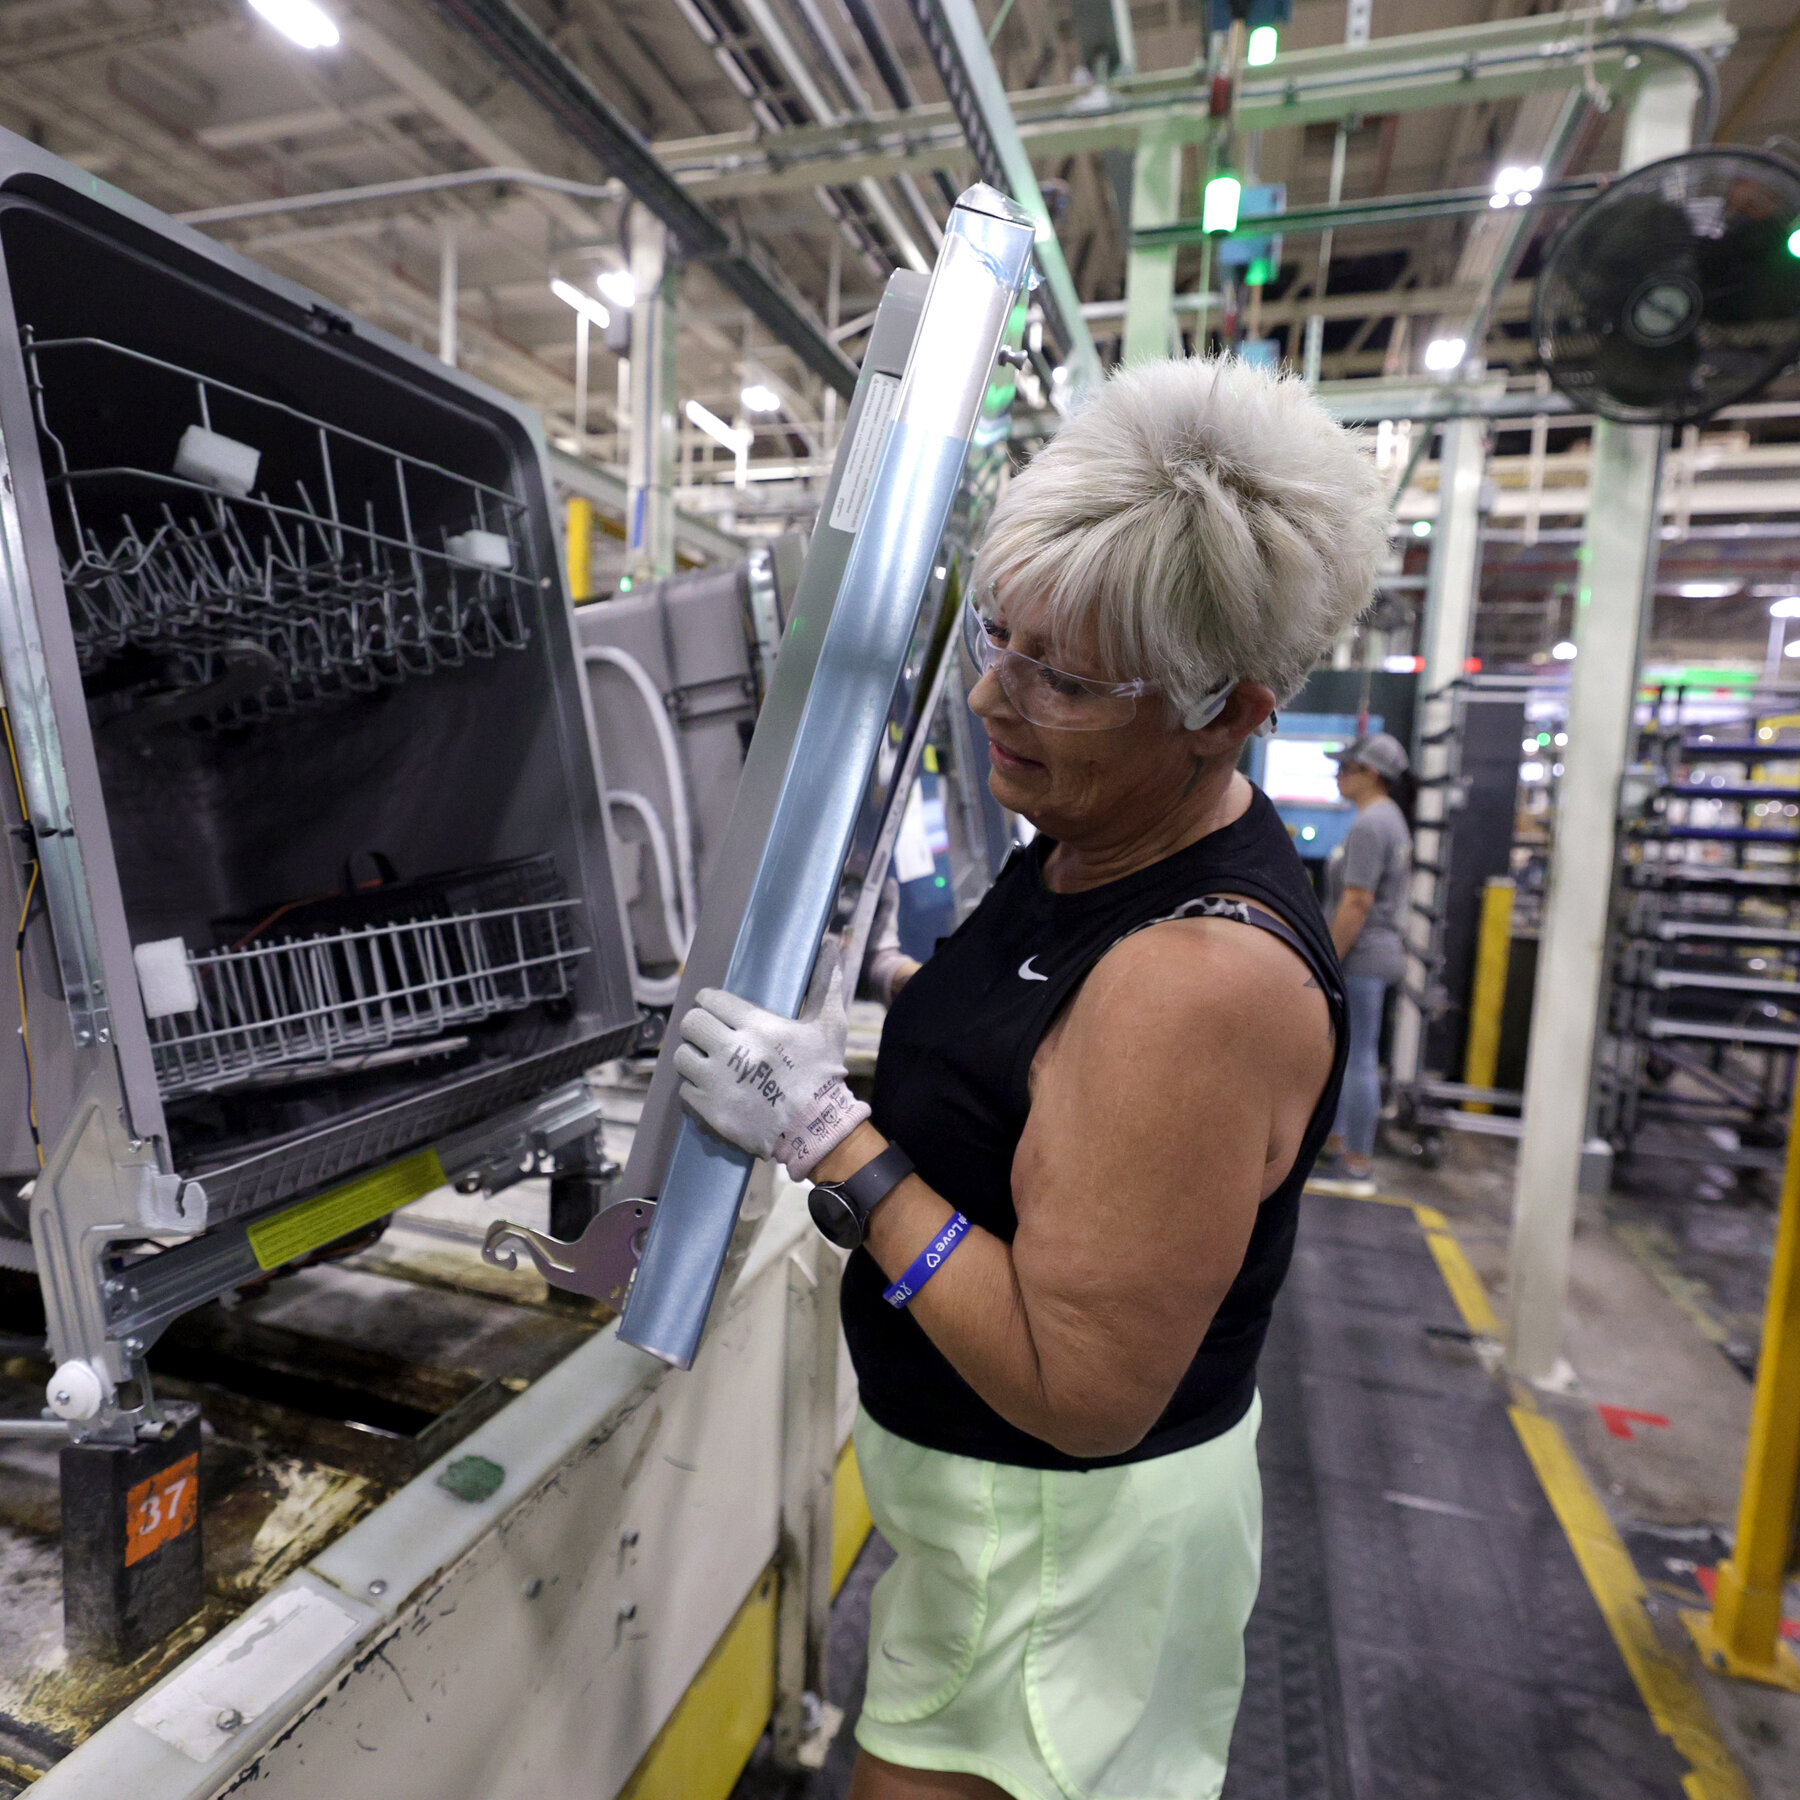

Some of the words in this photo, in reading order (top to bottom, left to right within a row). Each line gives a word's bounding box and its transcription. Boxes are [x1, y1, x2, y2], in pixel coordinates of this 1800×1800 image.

[727, 1046, 782, 1107] HyFlex
[935, 1222, 964, 1252] Love
[139, 1478, 187, 1536] 37
